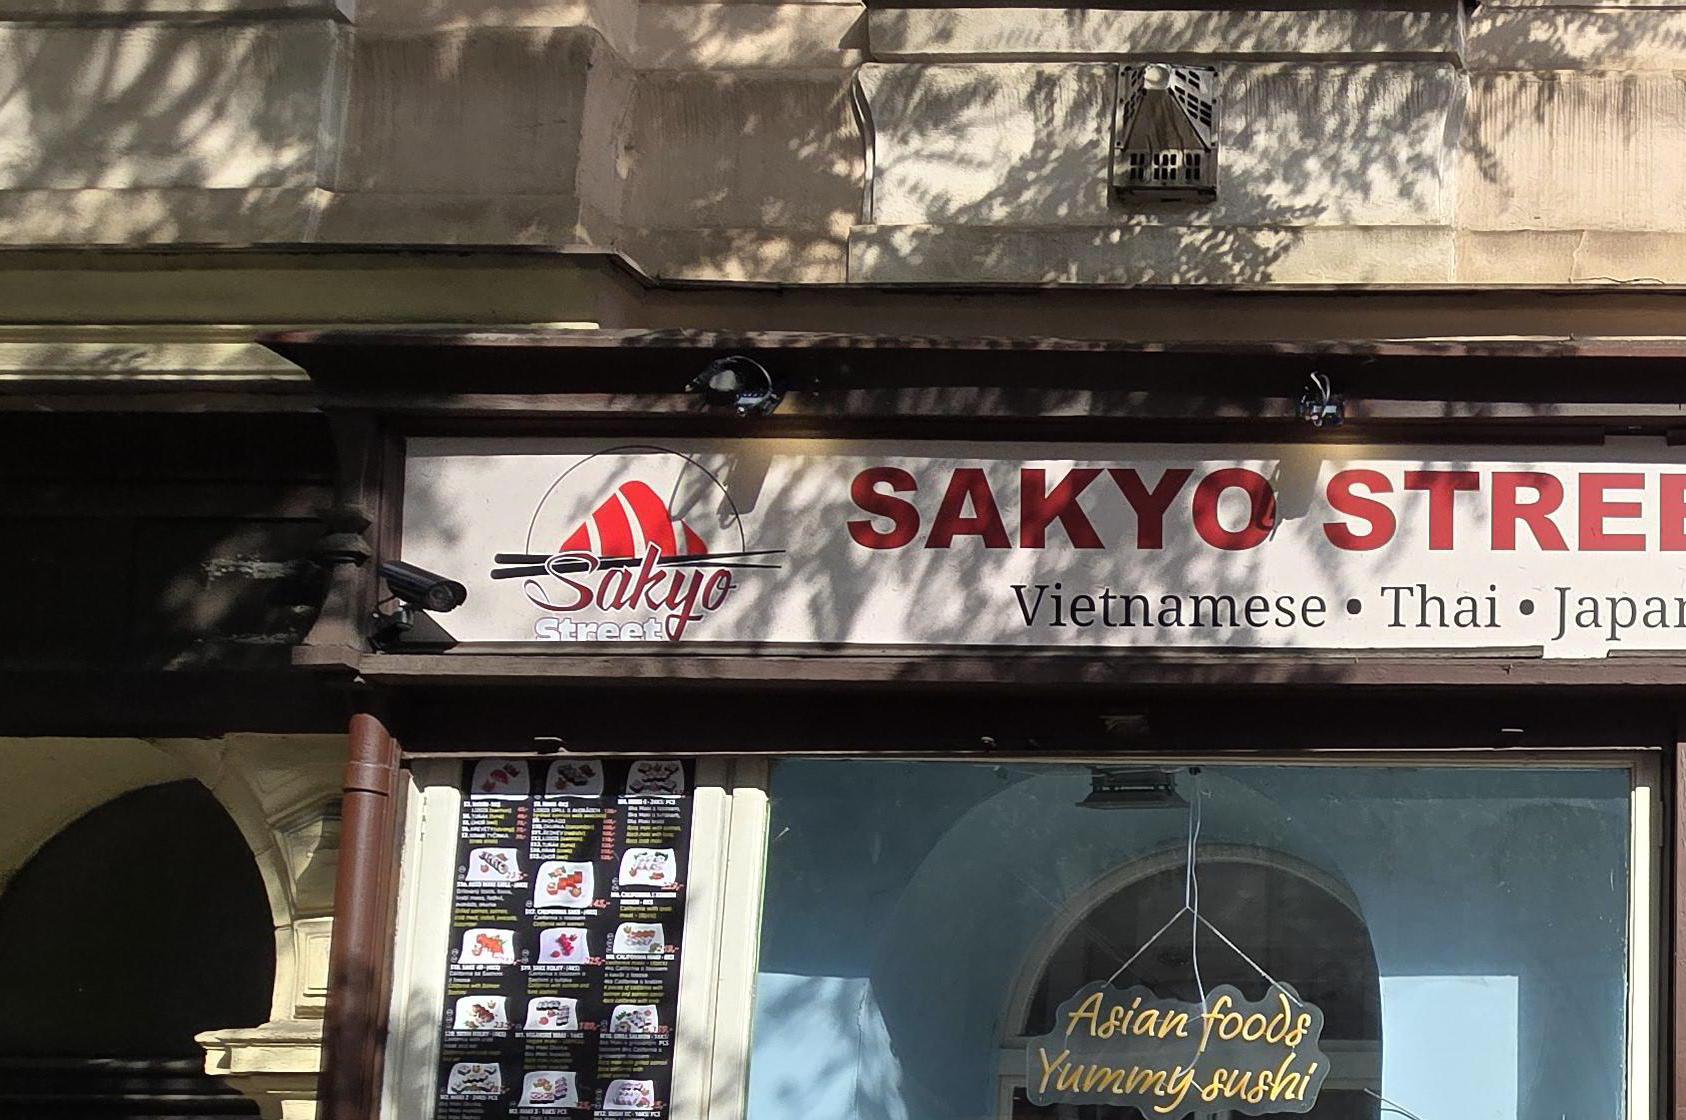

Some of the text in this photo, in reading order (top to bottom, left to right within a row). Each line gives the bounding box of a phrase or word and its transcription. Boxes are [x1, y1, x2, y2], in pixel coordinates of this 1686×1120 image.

[847, 467, 1278, 551] SAKYO
[523, 542, 736, 641] Sakyo
[1009, 584, 1327, 629] Vietnamese
[1381, 584, 1501, 629] Thai
[534, 617, 663, 642] Street
[1067, 992, 1312, 1053] Asian foods
[1039, 1047, 1319, 1114] Yummy sushi
